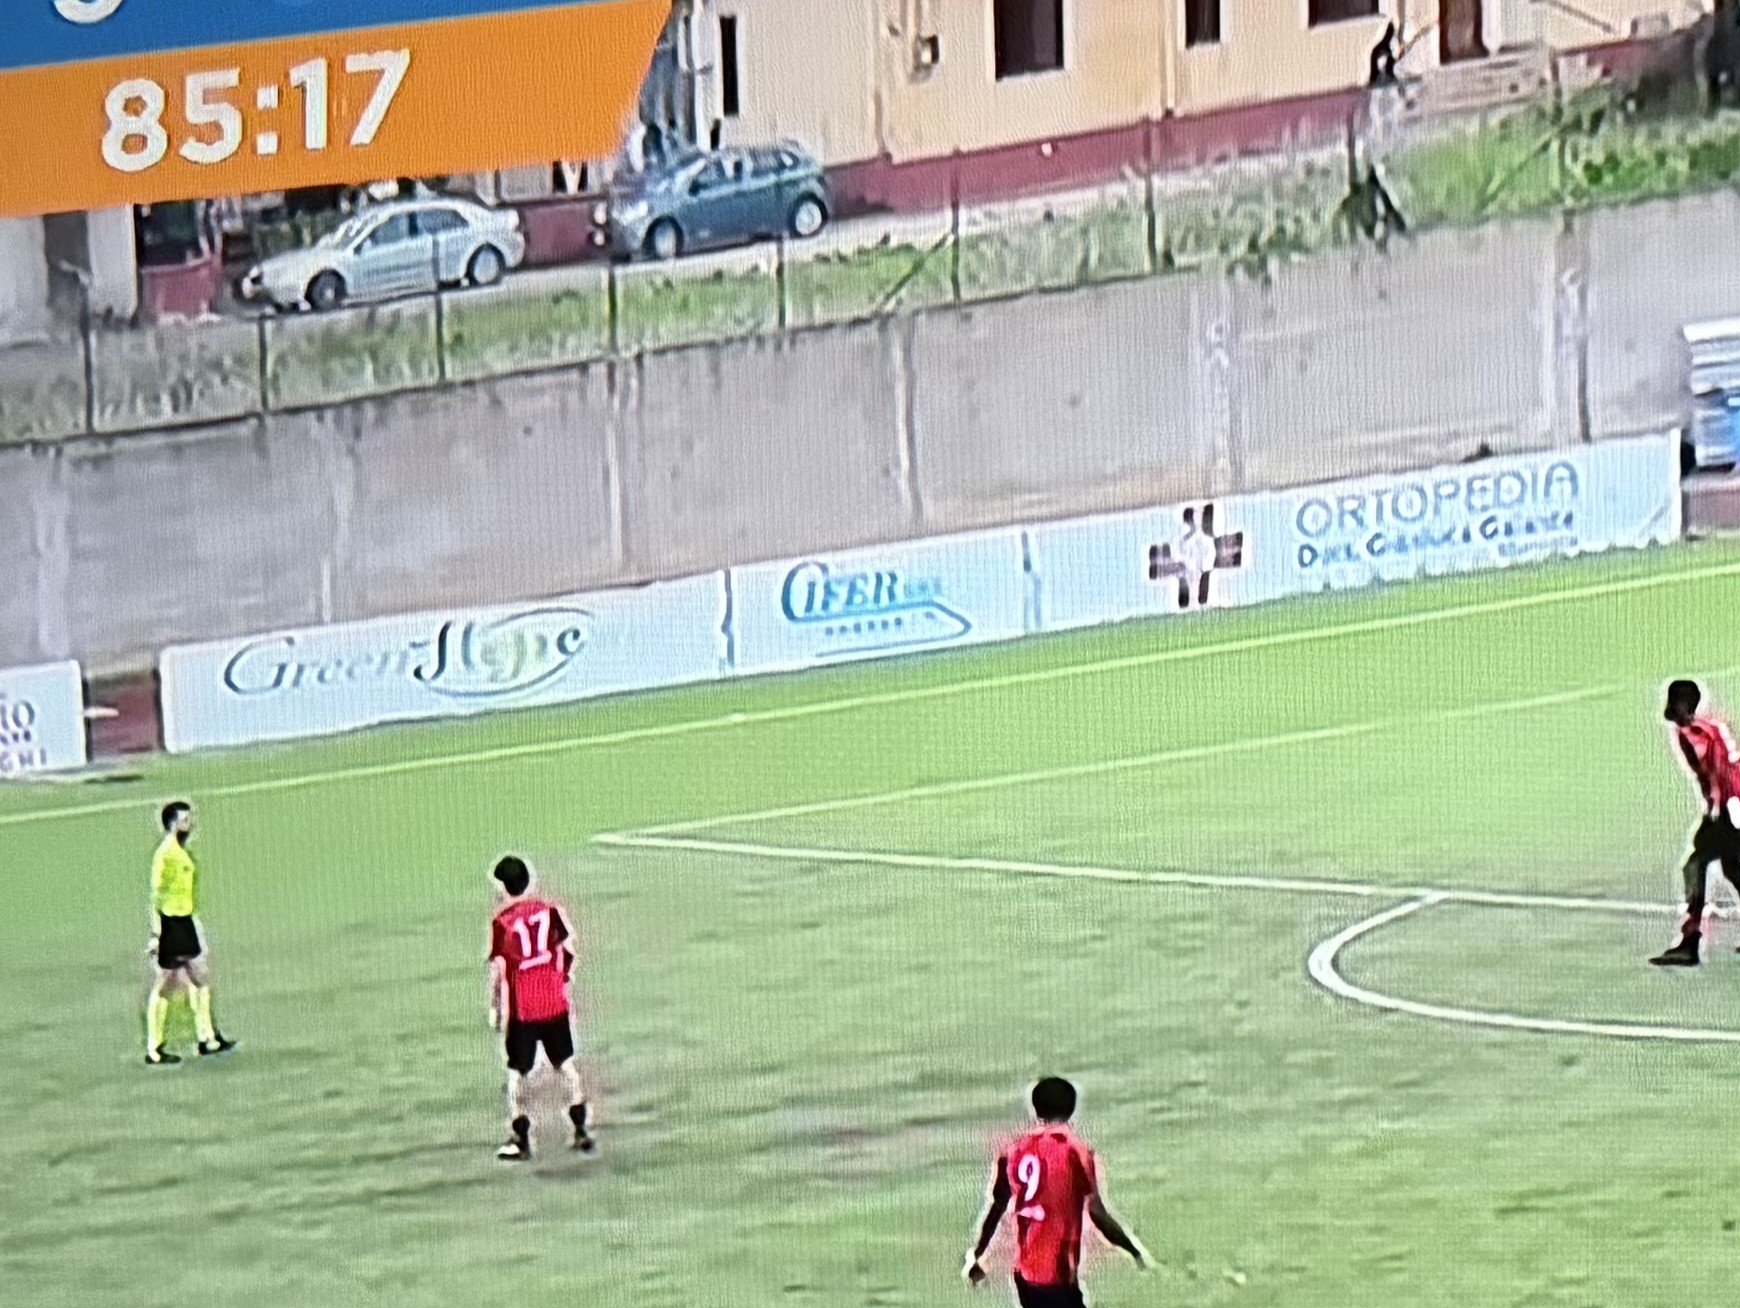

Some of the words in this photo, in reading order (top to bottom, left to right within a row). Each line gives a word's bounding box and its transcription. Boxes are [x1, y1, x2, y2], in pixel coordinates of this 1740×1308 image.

[100, 47, 412, 173] 85:17
[1295, 460, 1580, 538] ORTOPEDIA
[512, 908, 552, 958] 17
[1017, 1153, 1042, 1202] 9
